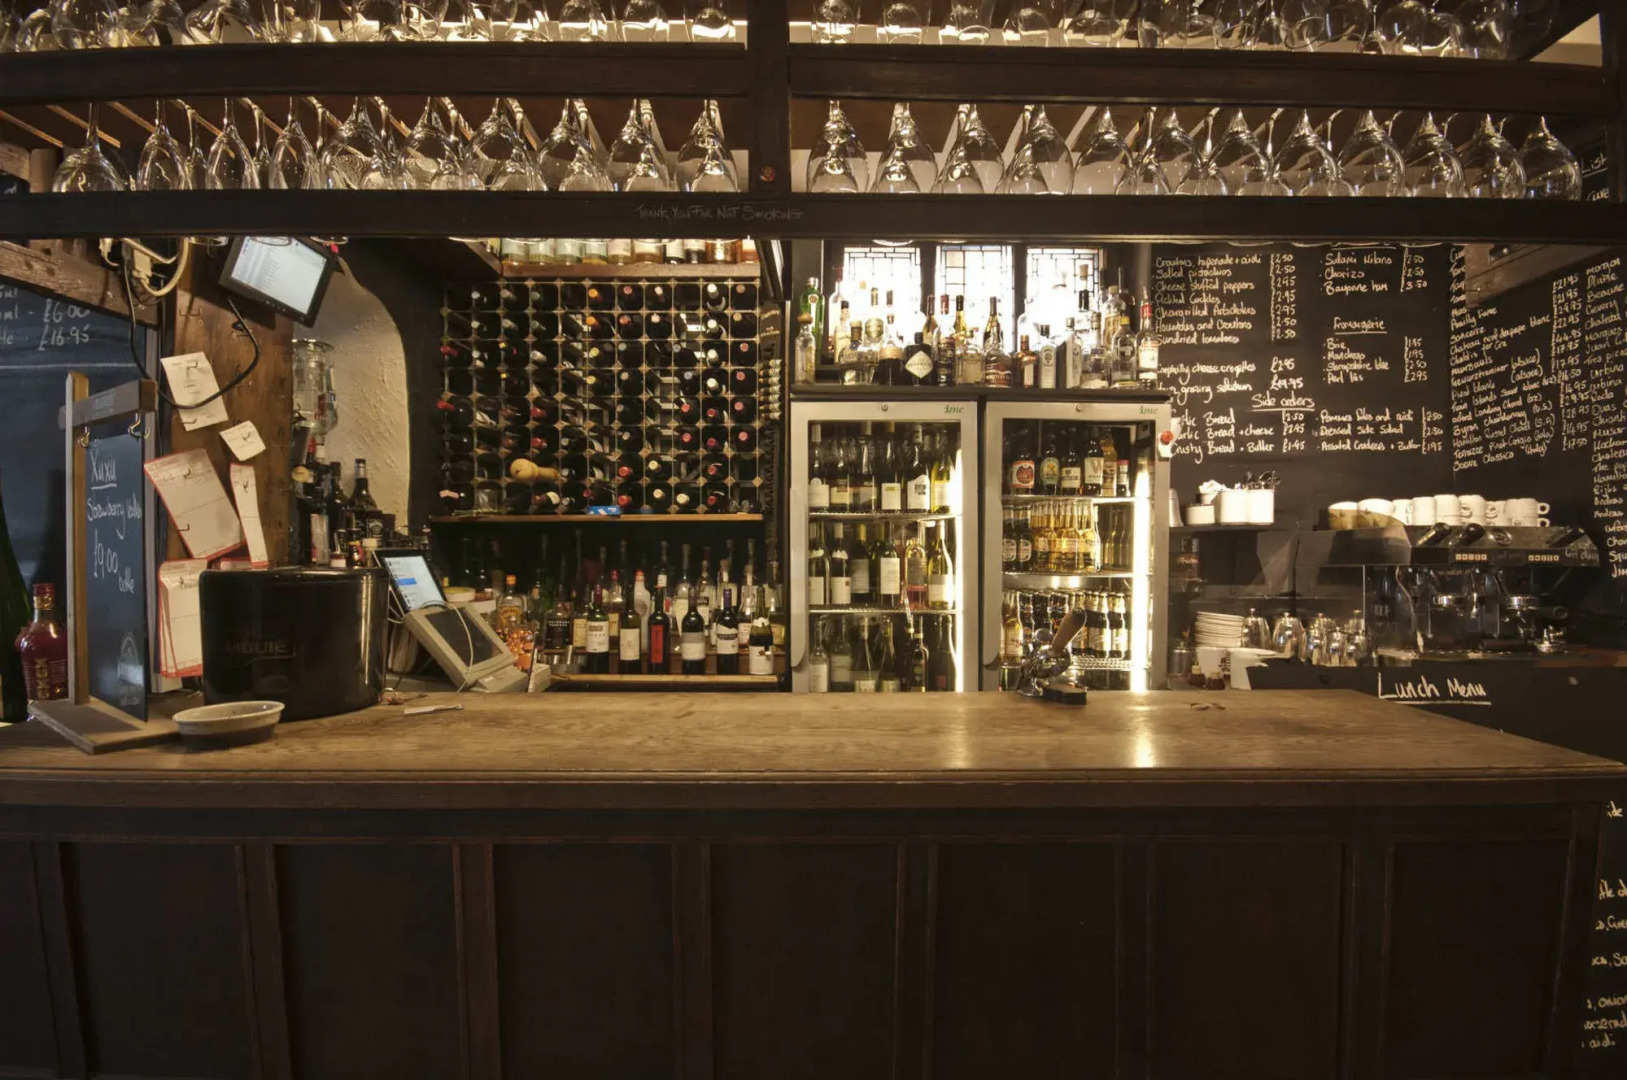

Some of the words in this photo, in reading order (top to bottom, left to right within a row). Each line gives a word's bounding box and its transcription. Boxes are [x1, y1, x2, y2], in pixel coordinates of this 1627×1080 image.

[1325, 251, 1357, 266] Salami
[1156, 269, 1184, 279] Salted
[1325, 266, 1365, 280] Chorizo
[1156, 281, 1187, 291] Cheese
[1197, 317, 1214, 330] and
[1327, 337, 1347, 350] Brie
[1252, 390, 1276, 408] Side
[1280, 390, 1315, 408] orders
[1203, 407, 1236, 425] Bread
[1375, 407, 1391, 421] and
[1177, 426, 1199, 440] arlic
[1207, 424, 1235, 439] Bread
[1208, 440, 1235, 454] Bread
[1377, 671, 1440, 699] Lunch
[1446, 677, 1487, 697] Menu
